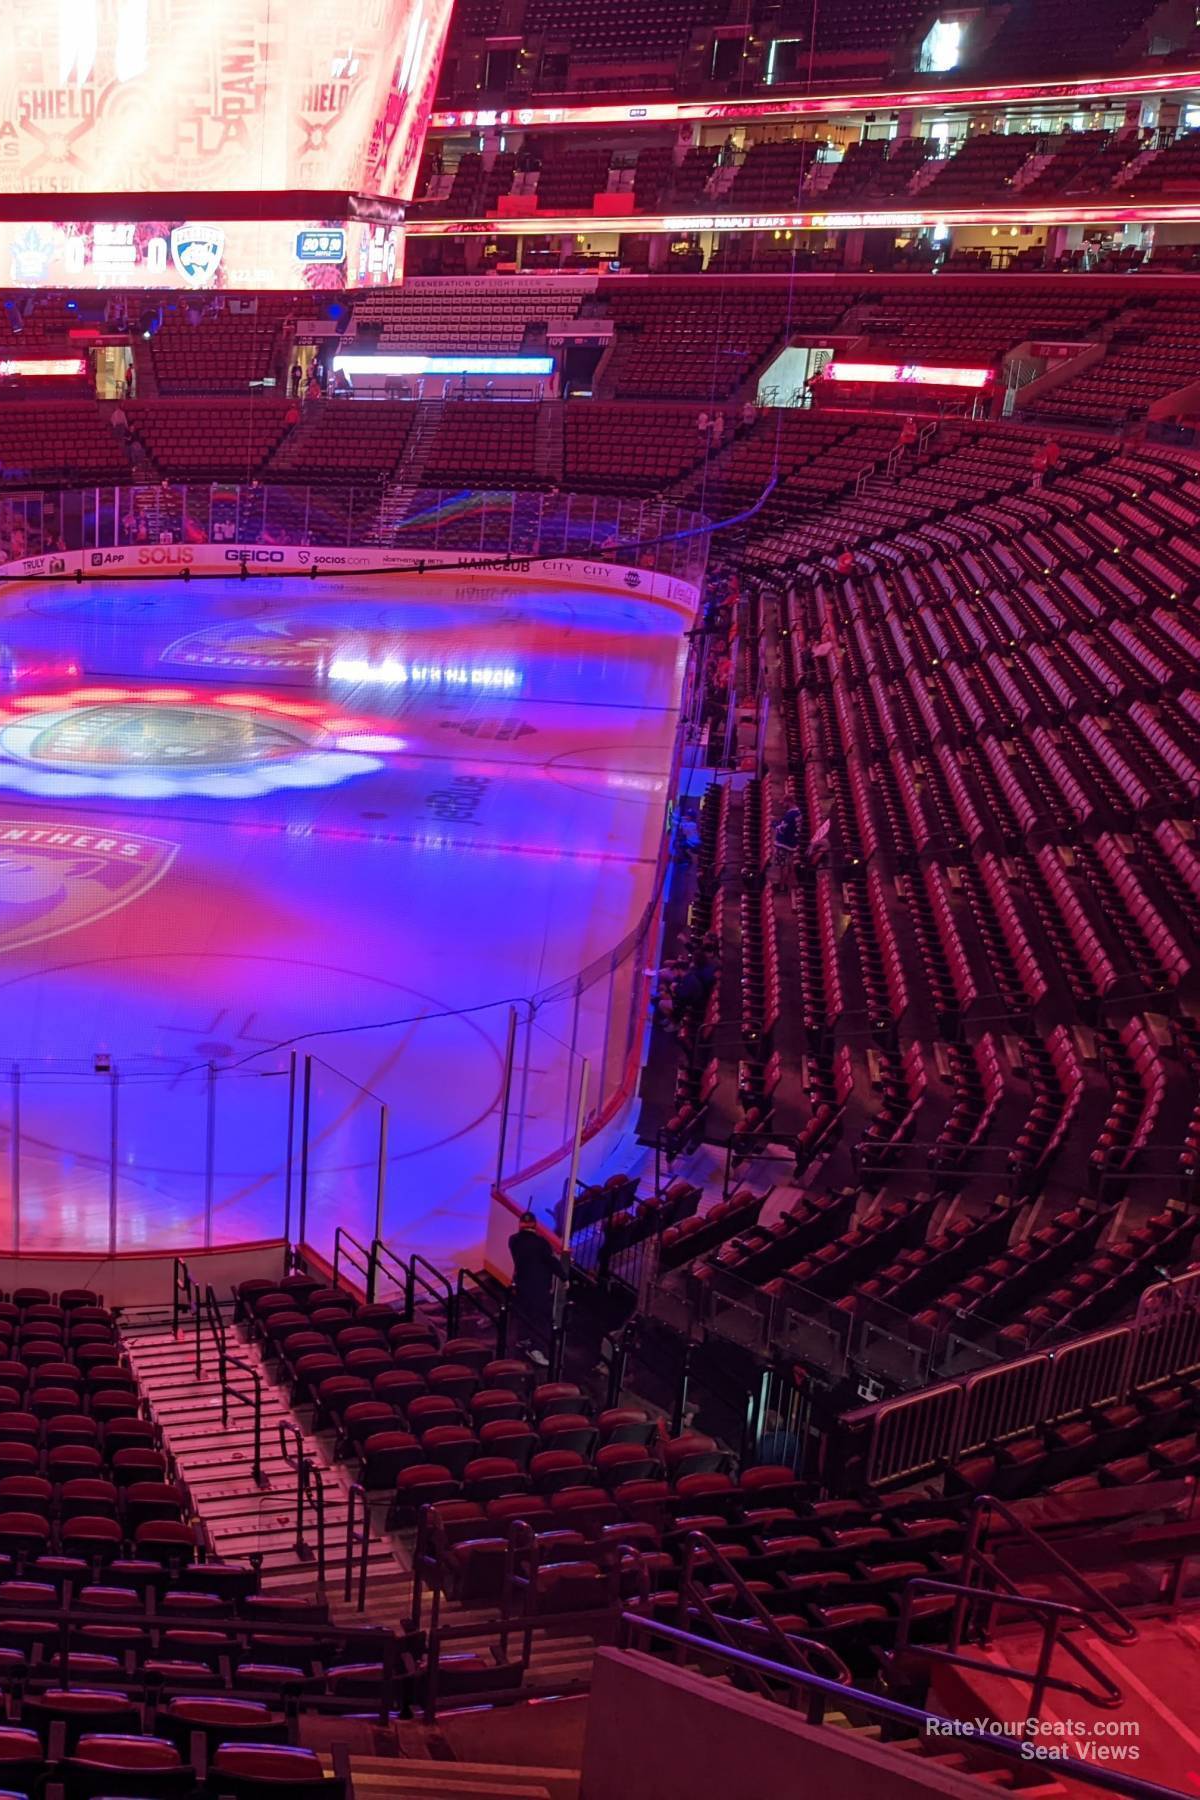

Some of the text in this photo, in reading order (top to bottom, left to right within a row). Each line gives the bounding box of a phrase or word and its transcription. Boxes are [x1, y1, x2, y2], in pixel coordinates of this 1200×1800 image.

[17, 89, 95, 121] SHIELD
[752, 217, 785, 227] LEAFS
[548, 337, 564, 345] 109
[138, 547, 193, 565] SOLIS
[225, 549, 285, 563] GEICO
[22, 557, 45, 570] TRULY
[543, 561, 574, 571] CITY
[583, 565, 611, 577] CITY
